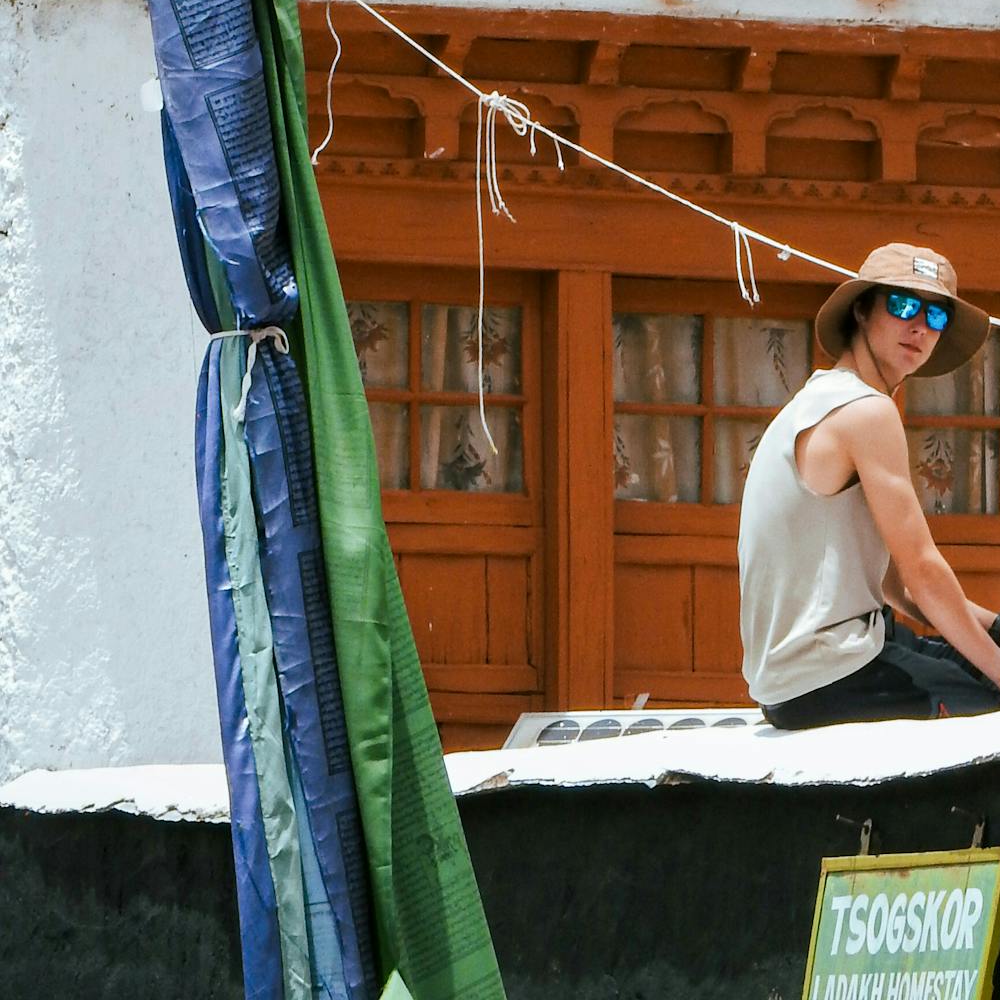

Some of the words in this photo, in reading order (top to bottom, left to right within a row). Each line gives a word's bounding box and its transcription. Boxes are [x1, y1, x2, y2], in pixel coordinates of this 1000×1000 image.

[830, 888, 983, 956] TSOGSKOR
[811, 973, 886, 1000] LADAKH
[887, 969, 978, 1000] HOMESTAY
